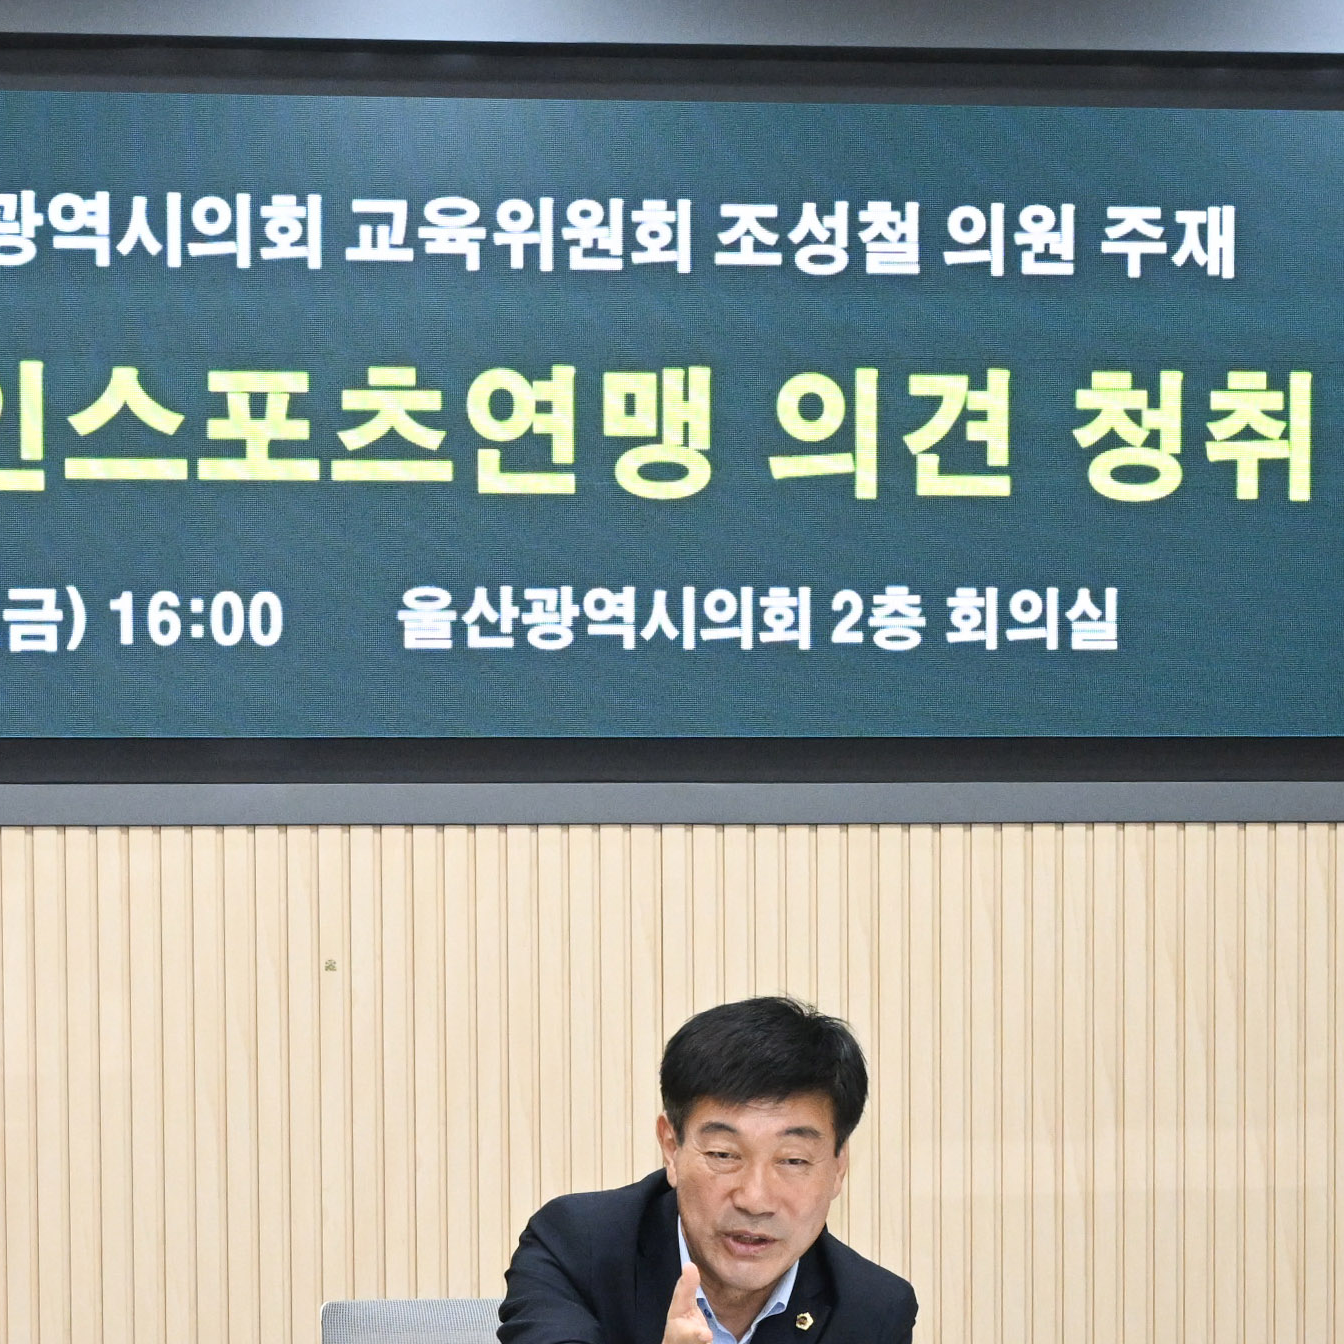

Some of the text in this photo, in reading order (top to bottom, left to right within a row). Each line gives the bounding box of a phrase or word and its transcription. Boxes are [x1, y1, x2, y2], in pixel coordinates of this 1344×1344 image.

[345, 196, 692, 274] 교육위원회
[714, 200, 921, 276] 조성철
[943, 202, 1076, 277] 의원
[1101, 205, 1235, 279] 주재
[769, 368, 1011, 500] 의견
[1072, 370, 1312, 502] 청취
[109, 590, 283, 647] 16:00
[397, 585, 1118, 651] 울산광역시의회 2층 회의실
